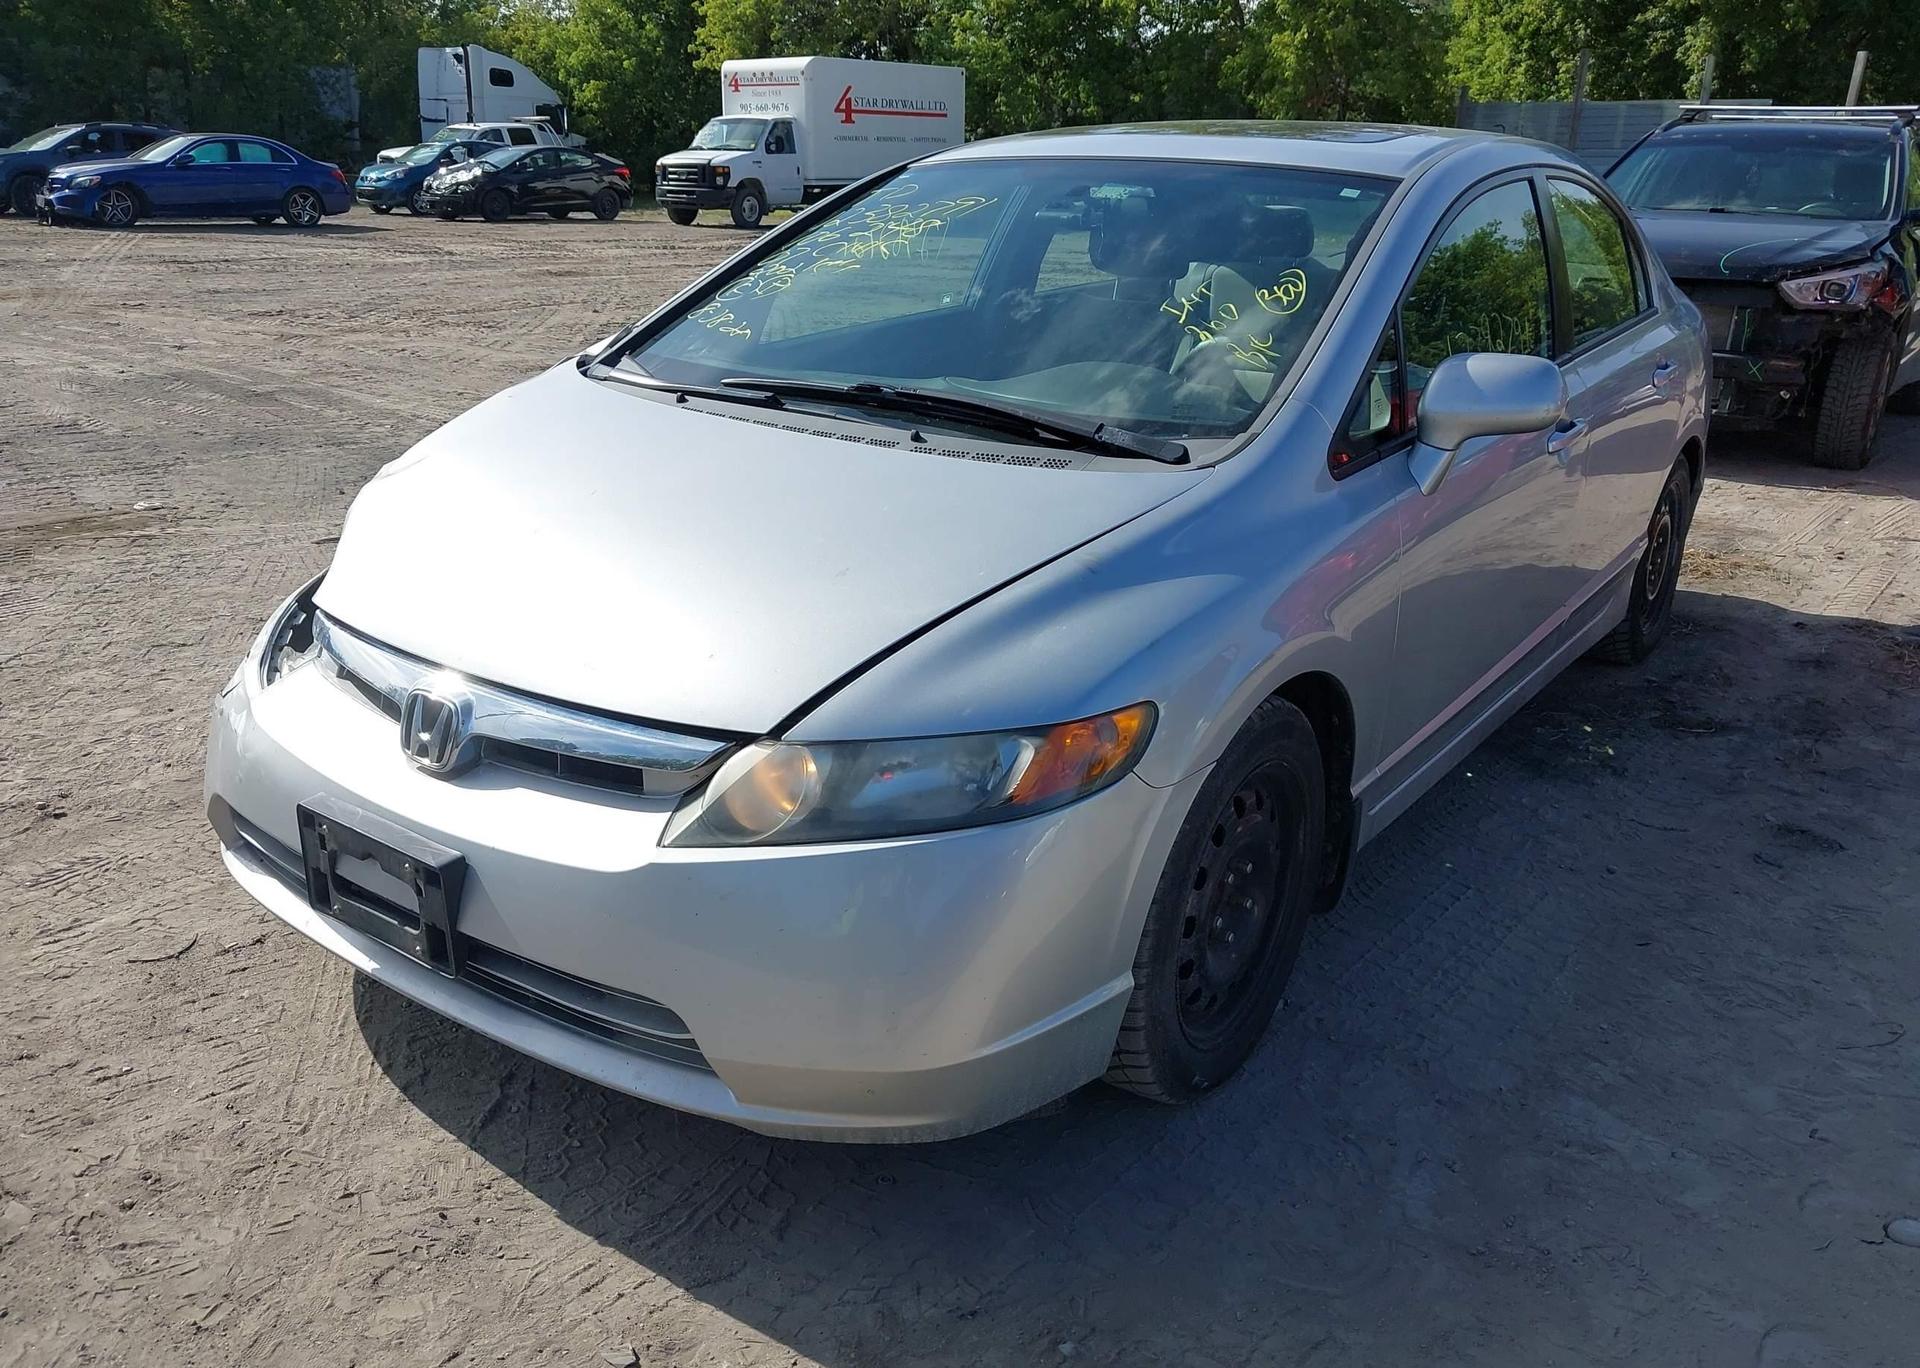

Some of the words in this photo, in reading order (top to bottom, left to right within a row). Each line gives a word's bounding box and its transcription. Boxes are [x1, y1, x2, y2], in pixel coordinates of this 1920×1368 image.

[728, 72, 741, 93] 4
[751, 89, 767, 97] Since
[739, 102, 790, 112] 905-660-9676
[834, 85, 855, 124] 4
[854, 96, 879, 107] STAR
[881, 97, 926, 110] DRYWALL
[928, 100, 948, 111] LTD.
